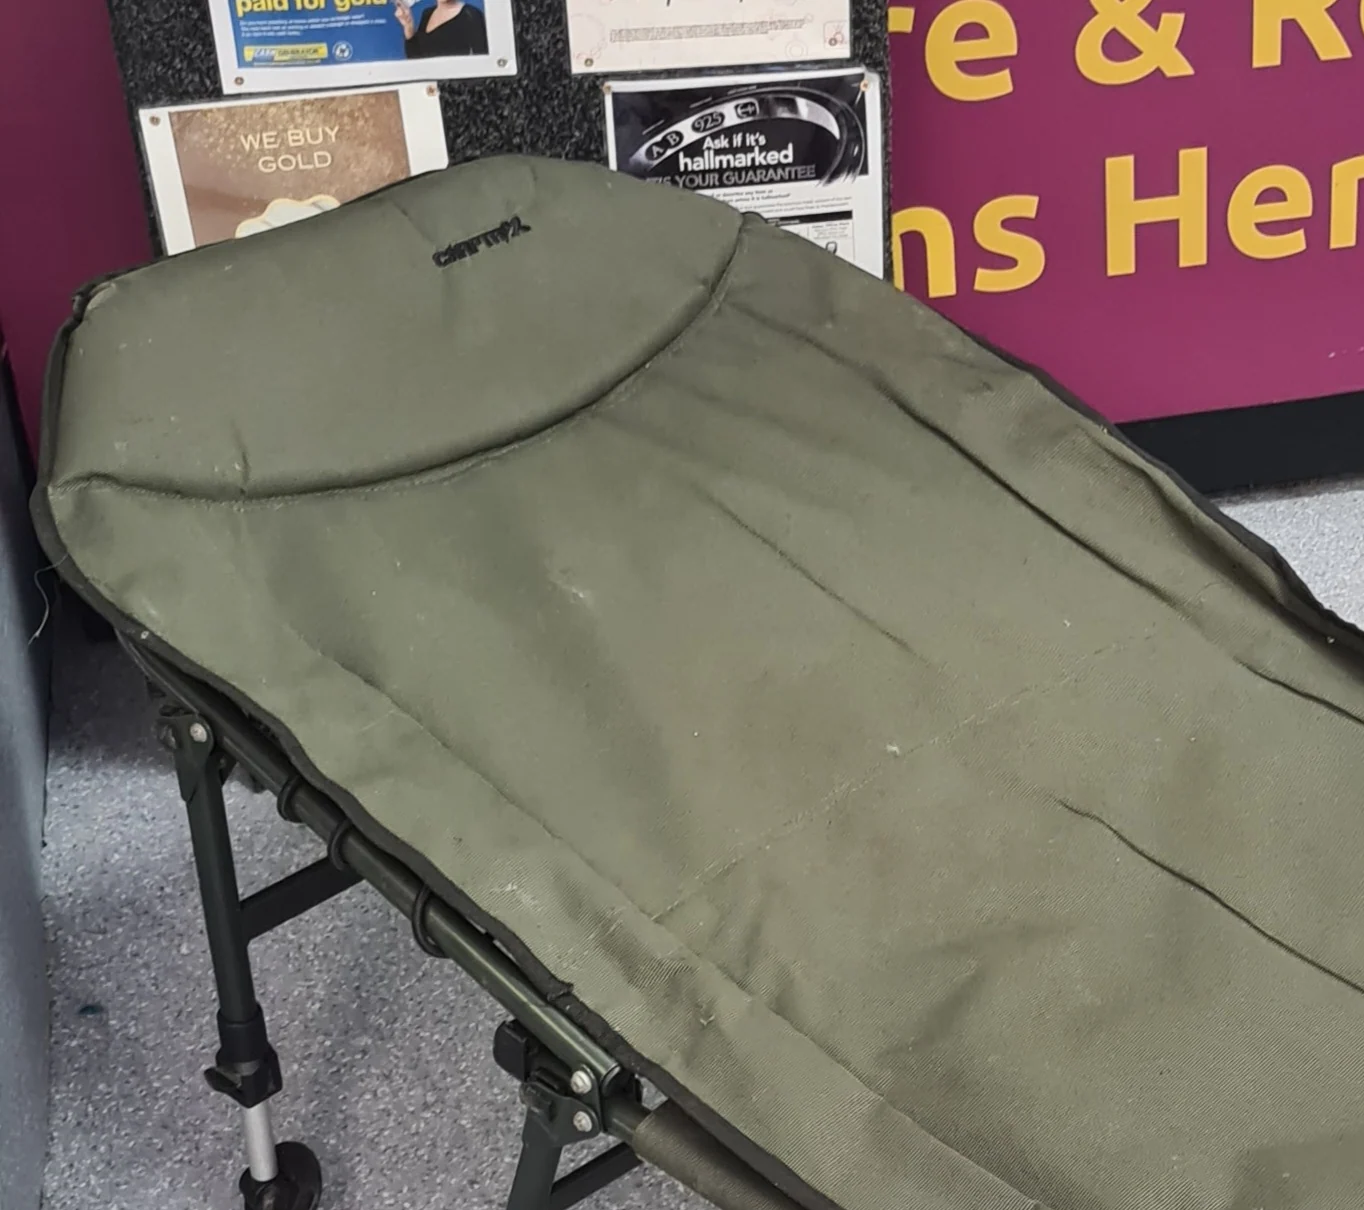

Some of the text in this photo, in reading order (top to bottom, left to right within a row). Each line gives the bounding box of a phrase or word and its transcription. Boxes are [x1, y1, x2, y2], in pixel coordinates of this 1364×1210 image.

[235, 0, 289, 17] paid
[1075, 0, 1196, 85] &
[694, 112, 722, 132] 925
[240, 126, 341, 151] WE BUY
[703, 132, 766, 149] Ask if it's
[257, 150, 333, 174] GOLD
[678, 144, 794, 172] hallmarked
[675, 171, 720, 188] YOUR
[722, 164, 817, 185] GUARANTEE
